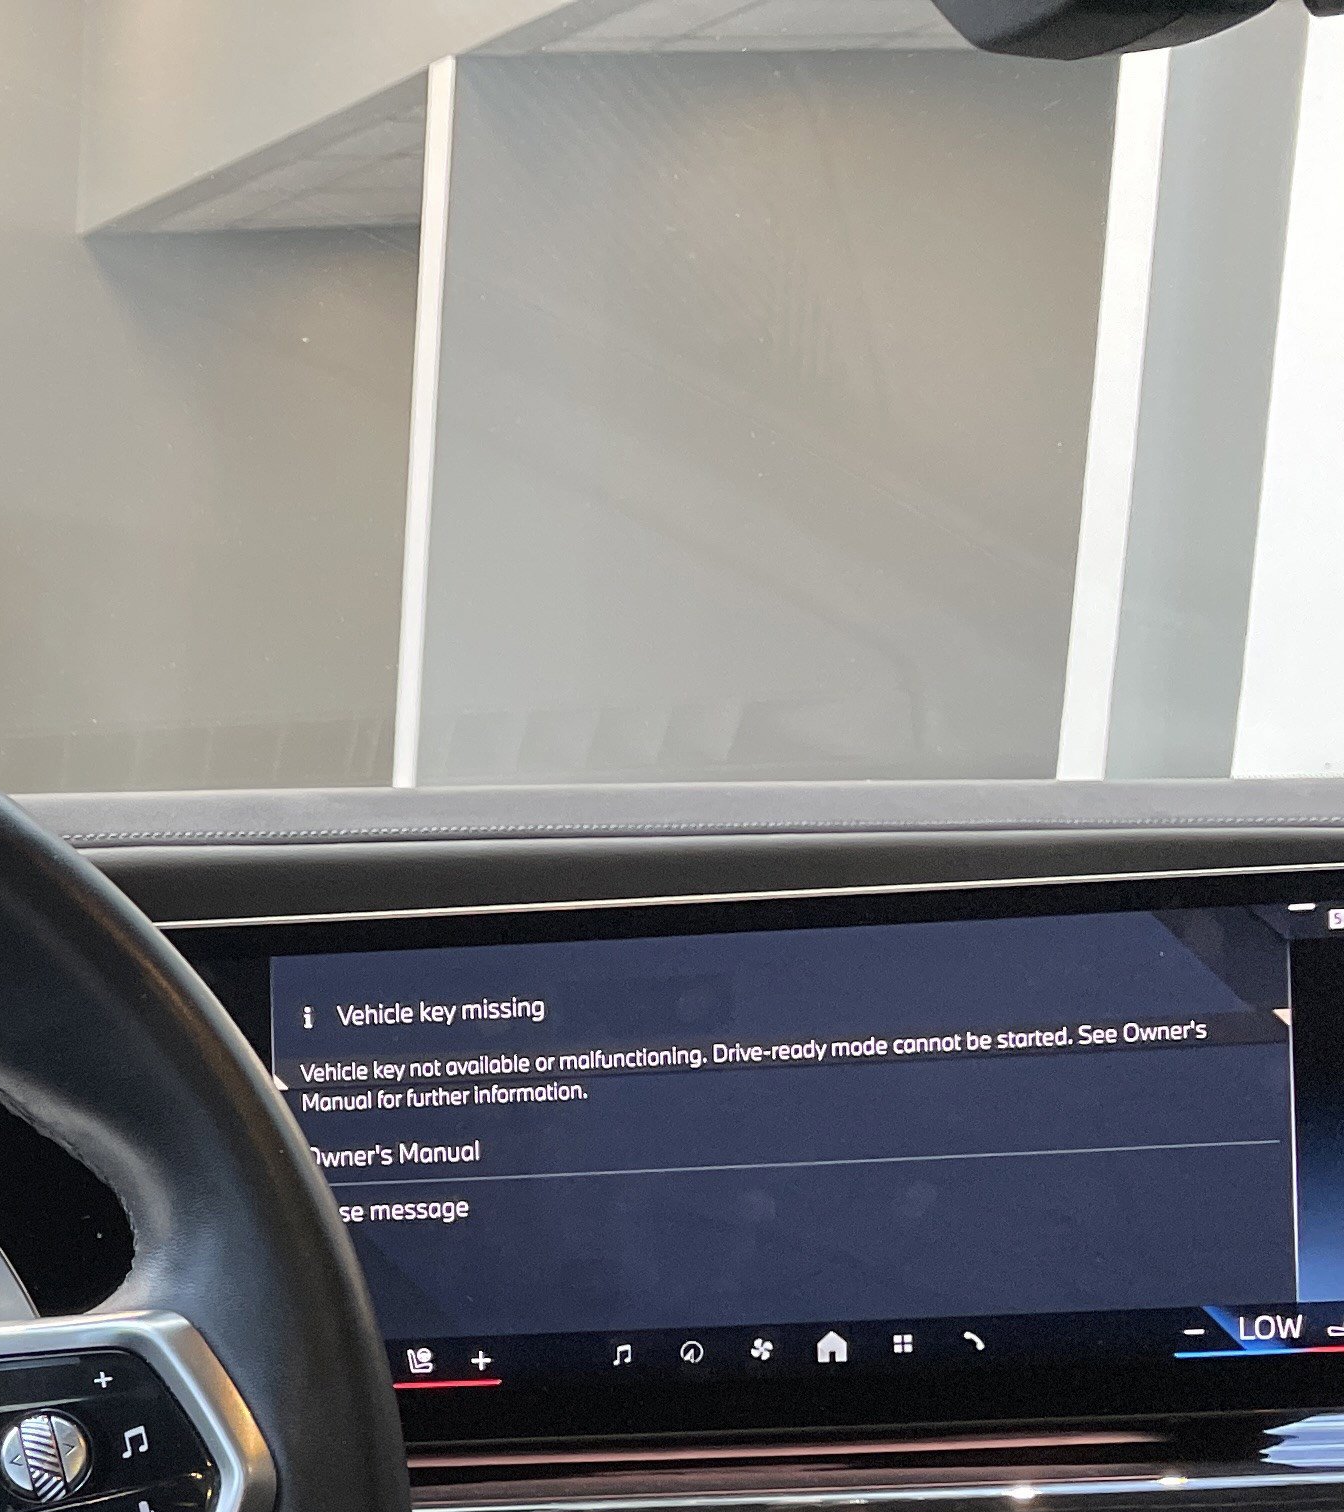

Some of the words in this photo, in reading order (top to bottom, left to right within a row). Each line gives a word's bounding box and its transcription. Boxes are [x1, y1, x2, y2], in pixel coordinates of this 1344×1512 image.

[336, 1002, 414, 1026] Vehicle
[419, 1001, 456, 1025] key
[461, 996, 545, 1023] missing
[300, 1060, 368, 1083] Vehicle
[373, 1060, 406, 1082] key
[409, 1059, 441, 1078] not
[445, 1054, 530, 1077] available
[535, 1056, 555, 1072] or
[559, 1046, 708, 1070] malfunctioning.
[713, 1039, 827, 1064] Drive-ready
[831, 1036, 888, 1058] mode
[892, 1033, 961, 1055] cannot
[966, 1031, 992, 1051] be
[997, 1026, 1073, 1049] started.
[1078, 1024, 1118, 1045] See
[1123, 1019, 1207, 1043] Owner's
[301, 1090, 372, 1112] Manual
[377, 1088, 402, 1109] for
[406, 1087, 470, 1108] further
[473, 1081, 588, 1104] information.
[399, 1140, 480, 1163] Manual
[370, 1200, 469, 1223] message
[1238, 1315, 1304, 1342] LOW
